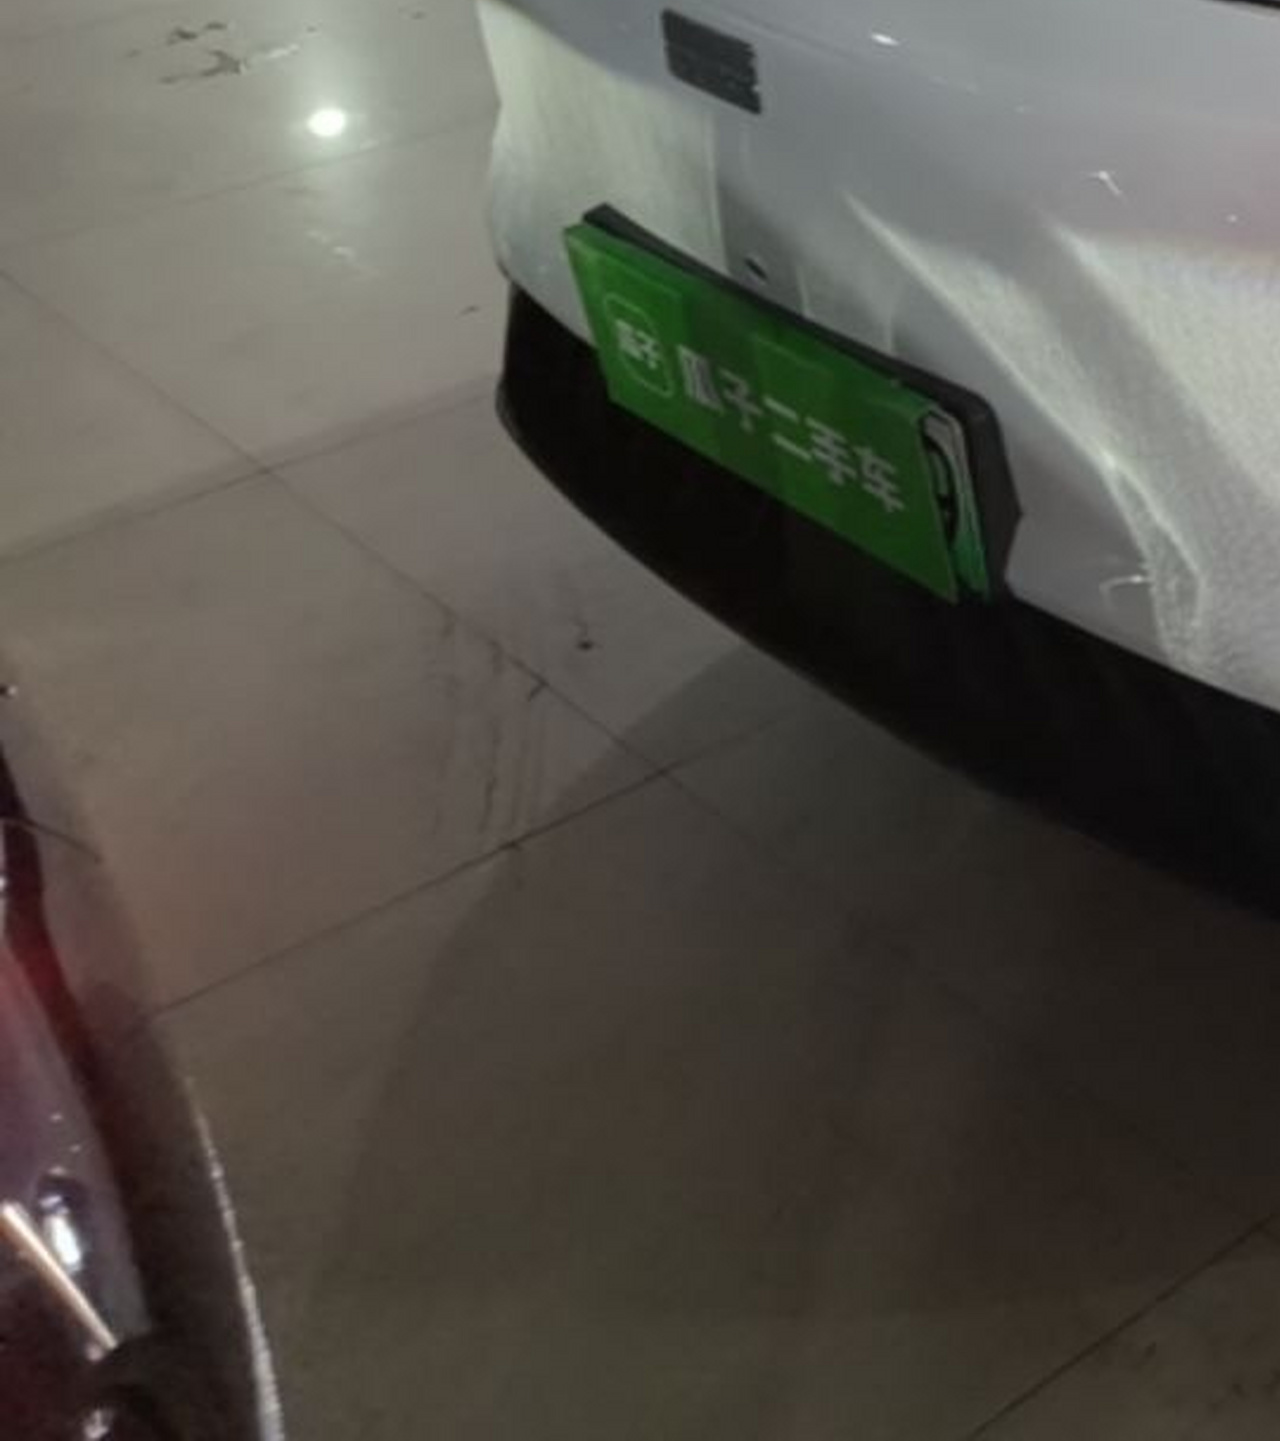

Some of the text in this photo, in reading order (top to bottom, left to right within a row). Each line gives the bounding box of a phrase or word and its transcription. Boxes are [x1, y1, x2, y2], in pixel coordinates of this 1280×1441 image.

[677, 343, 905, 513] 瓜子二手车
